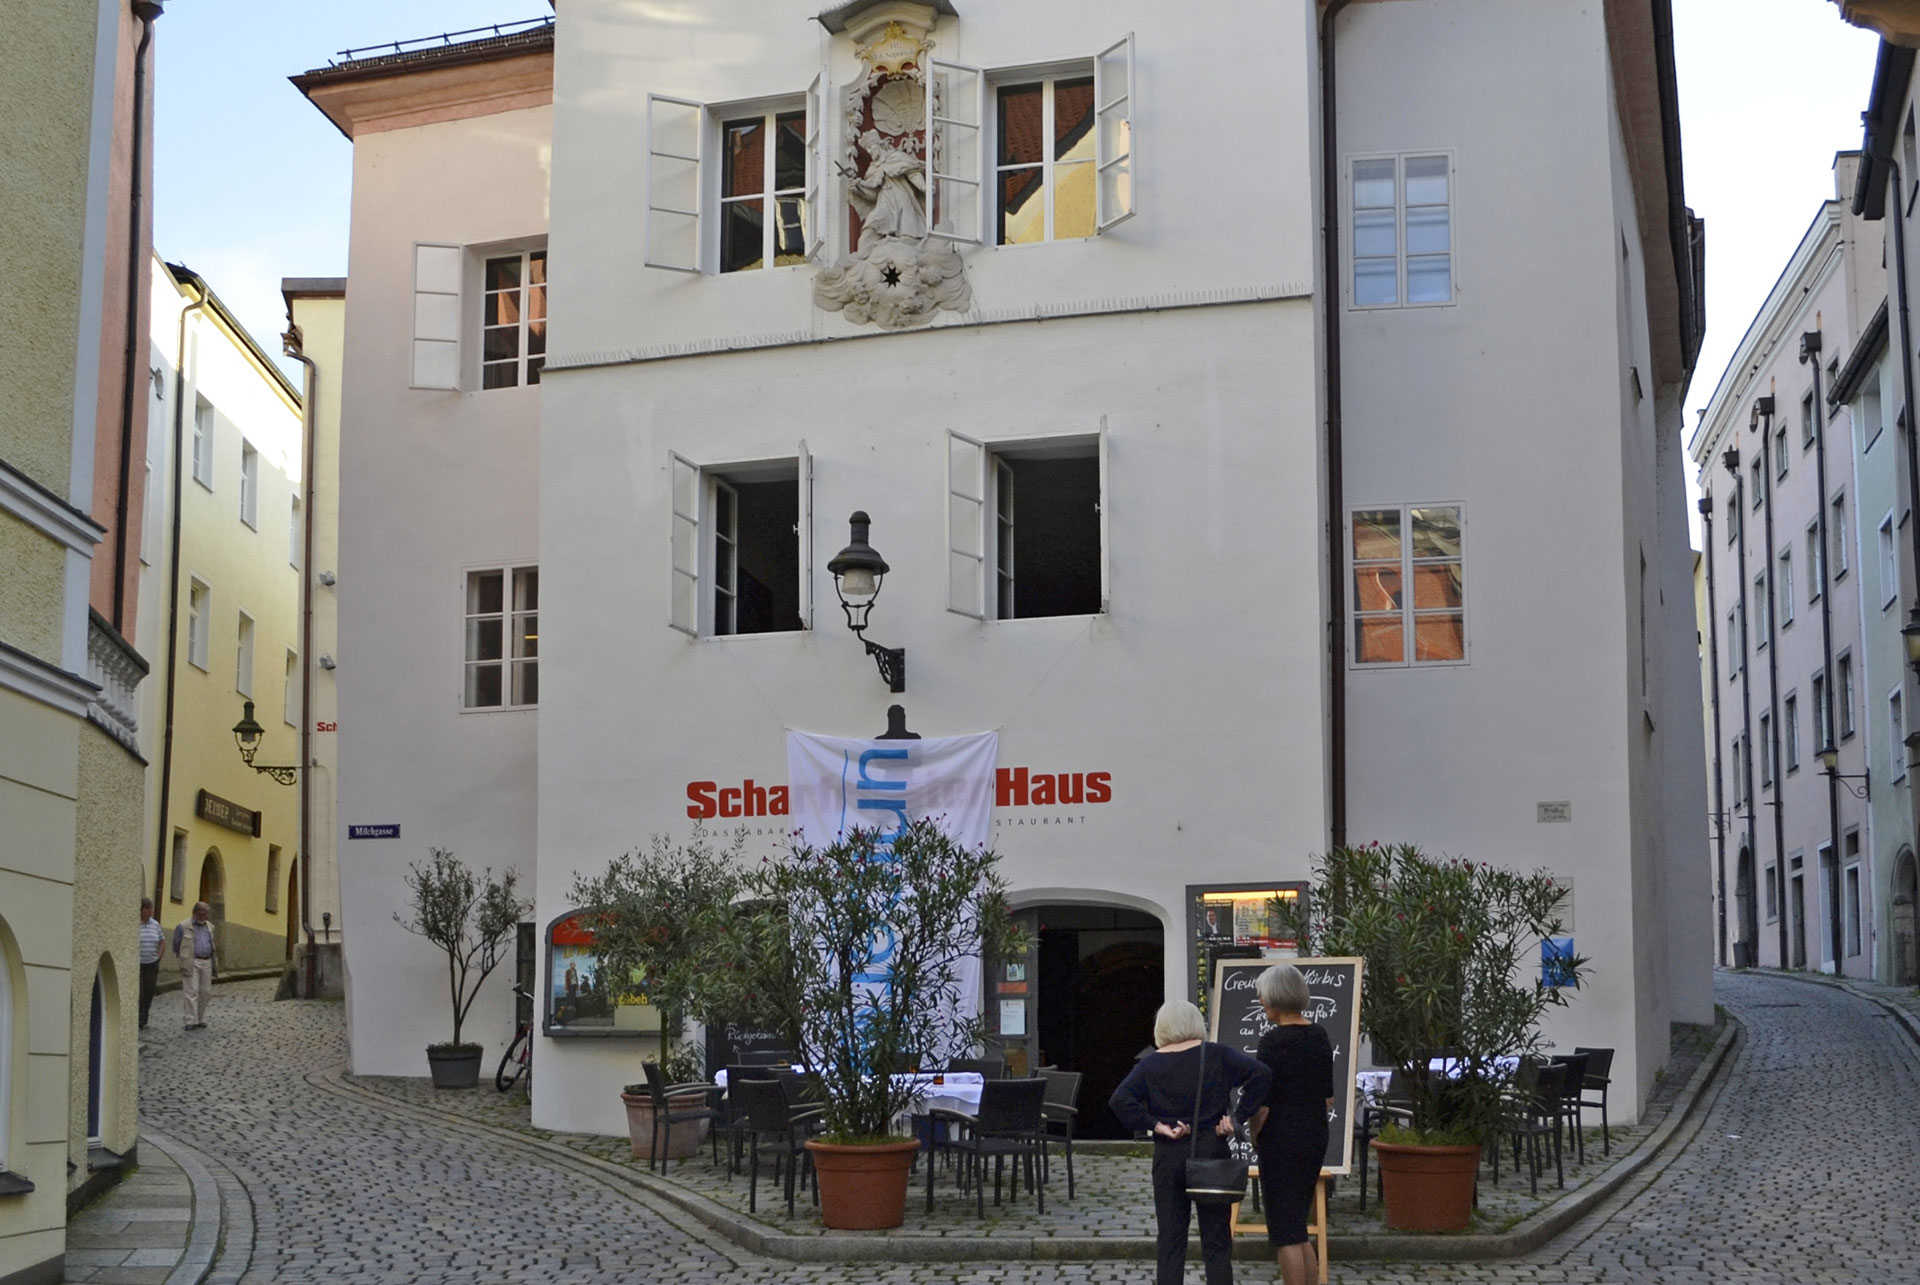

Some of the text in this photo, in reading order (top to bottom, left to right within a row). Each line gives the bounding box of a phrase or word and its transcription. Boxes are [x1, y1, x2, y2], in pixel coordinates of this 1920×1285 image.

[686, 767, 1112, 819] Scha Haus
[995, 815, 1087, 827] STAURANT
[355, 826, 394, 837] Milchgasse
[1303, 968, 1346, 987] Kürbis
